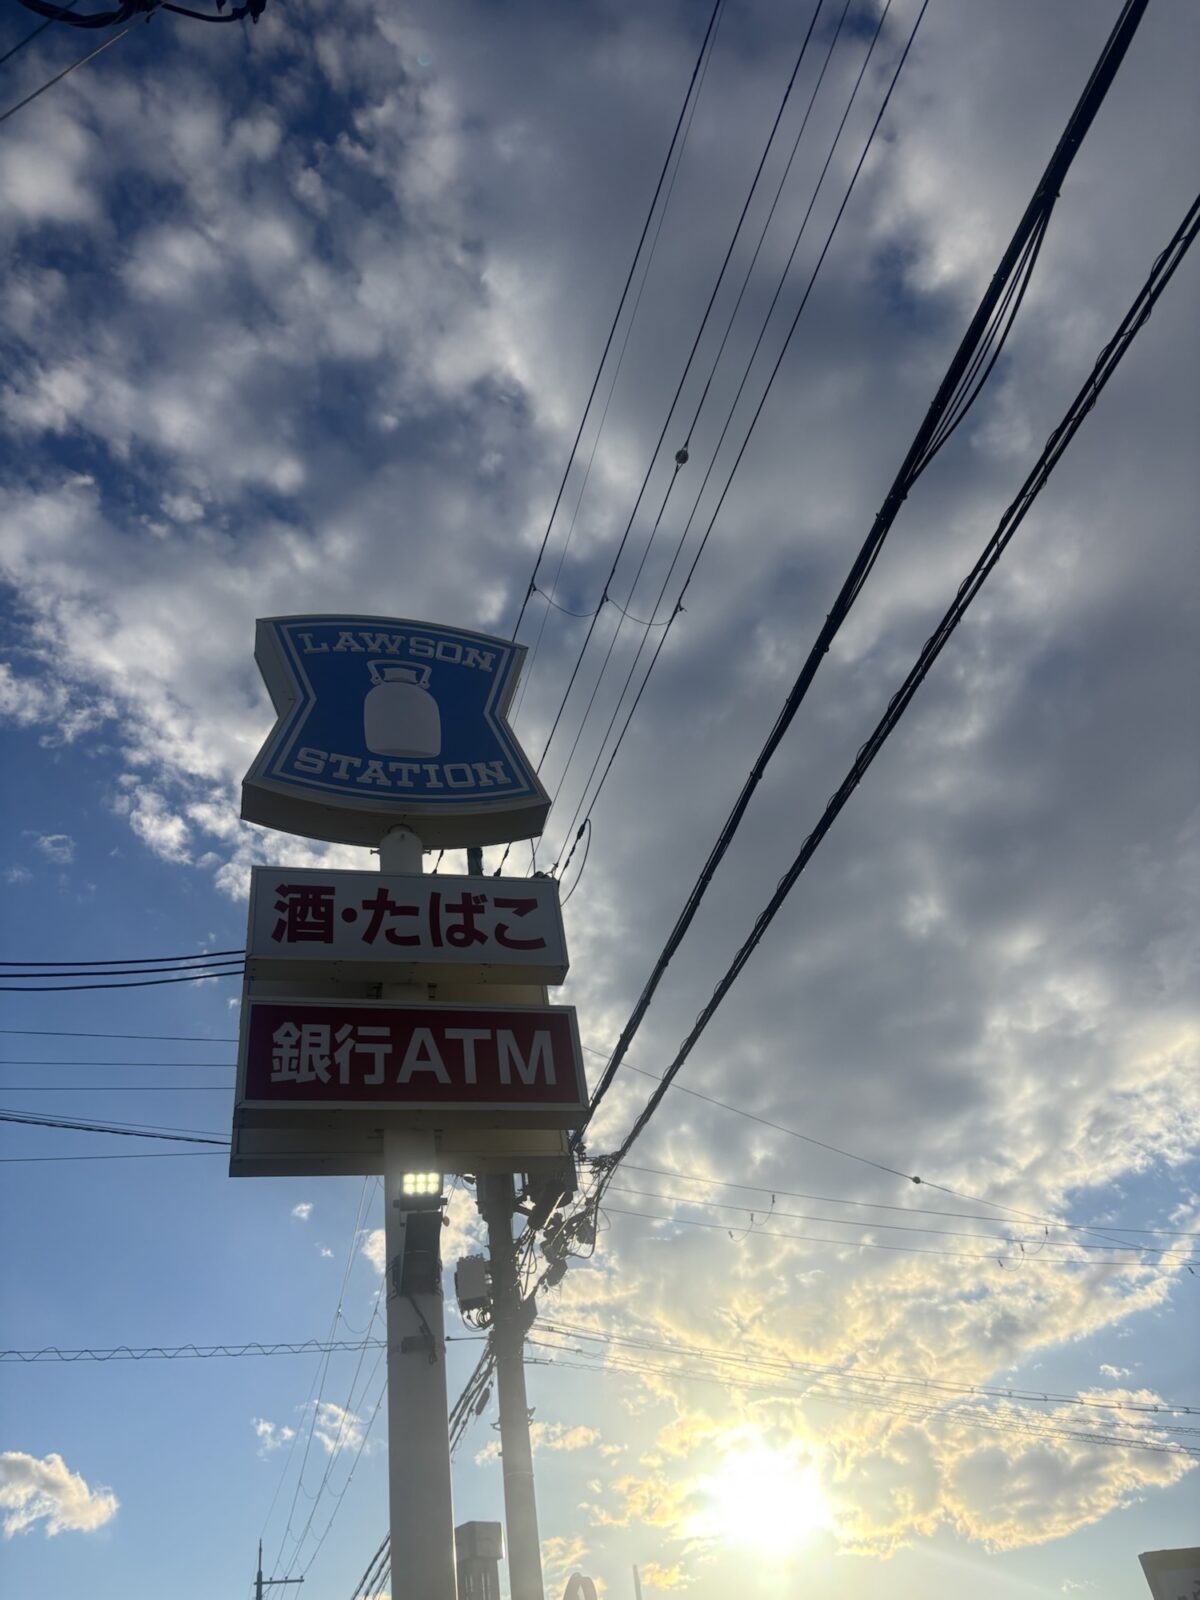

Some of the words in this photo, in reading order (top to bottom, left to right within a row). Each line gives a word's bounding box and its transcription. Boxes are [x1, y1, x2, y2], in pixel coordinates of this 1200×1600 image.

[298, 631, 497, 672] LAWSON
[294, 747, 512, 788] STATION
[270, 1021, 557, 1086] 銀行ATM
